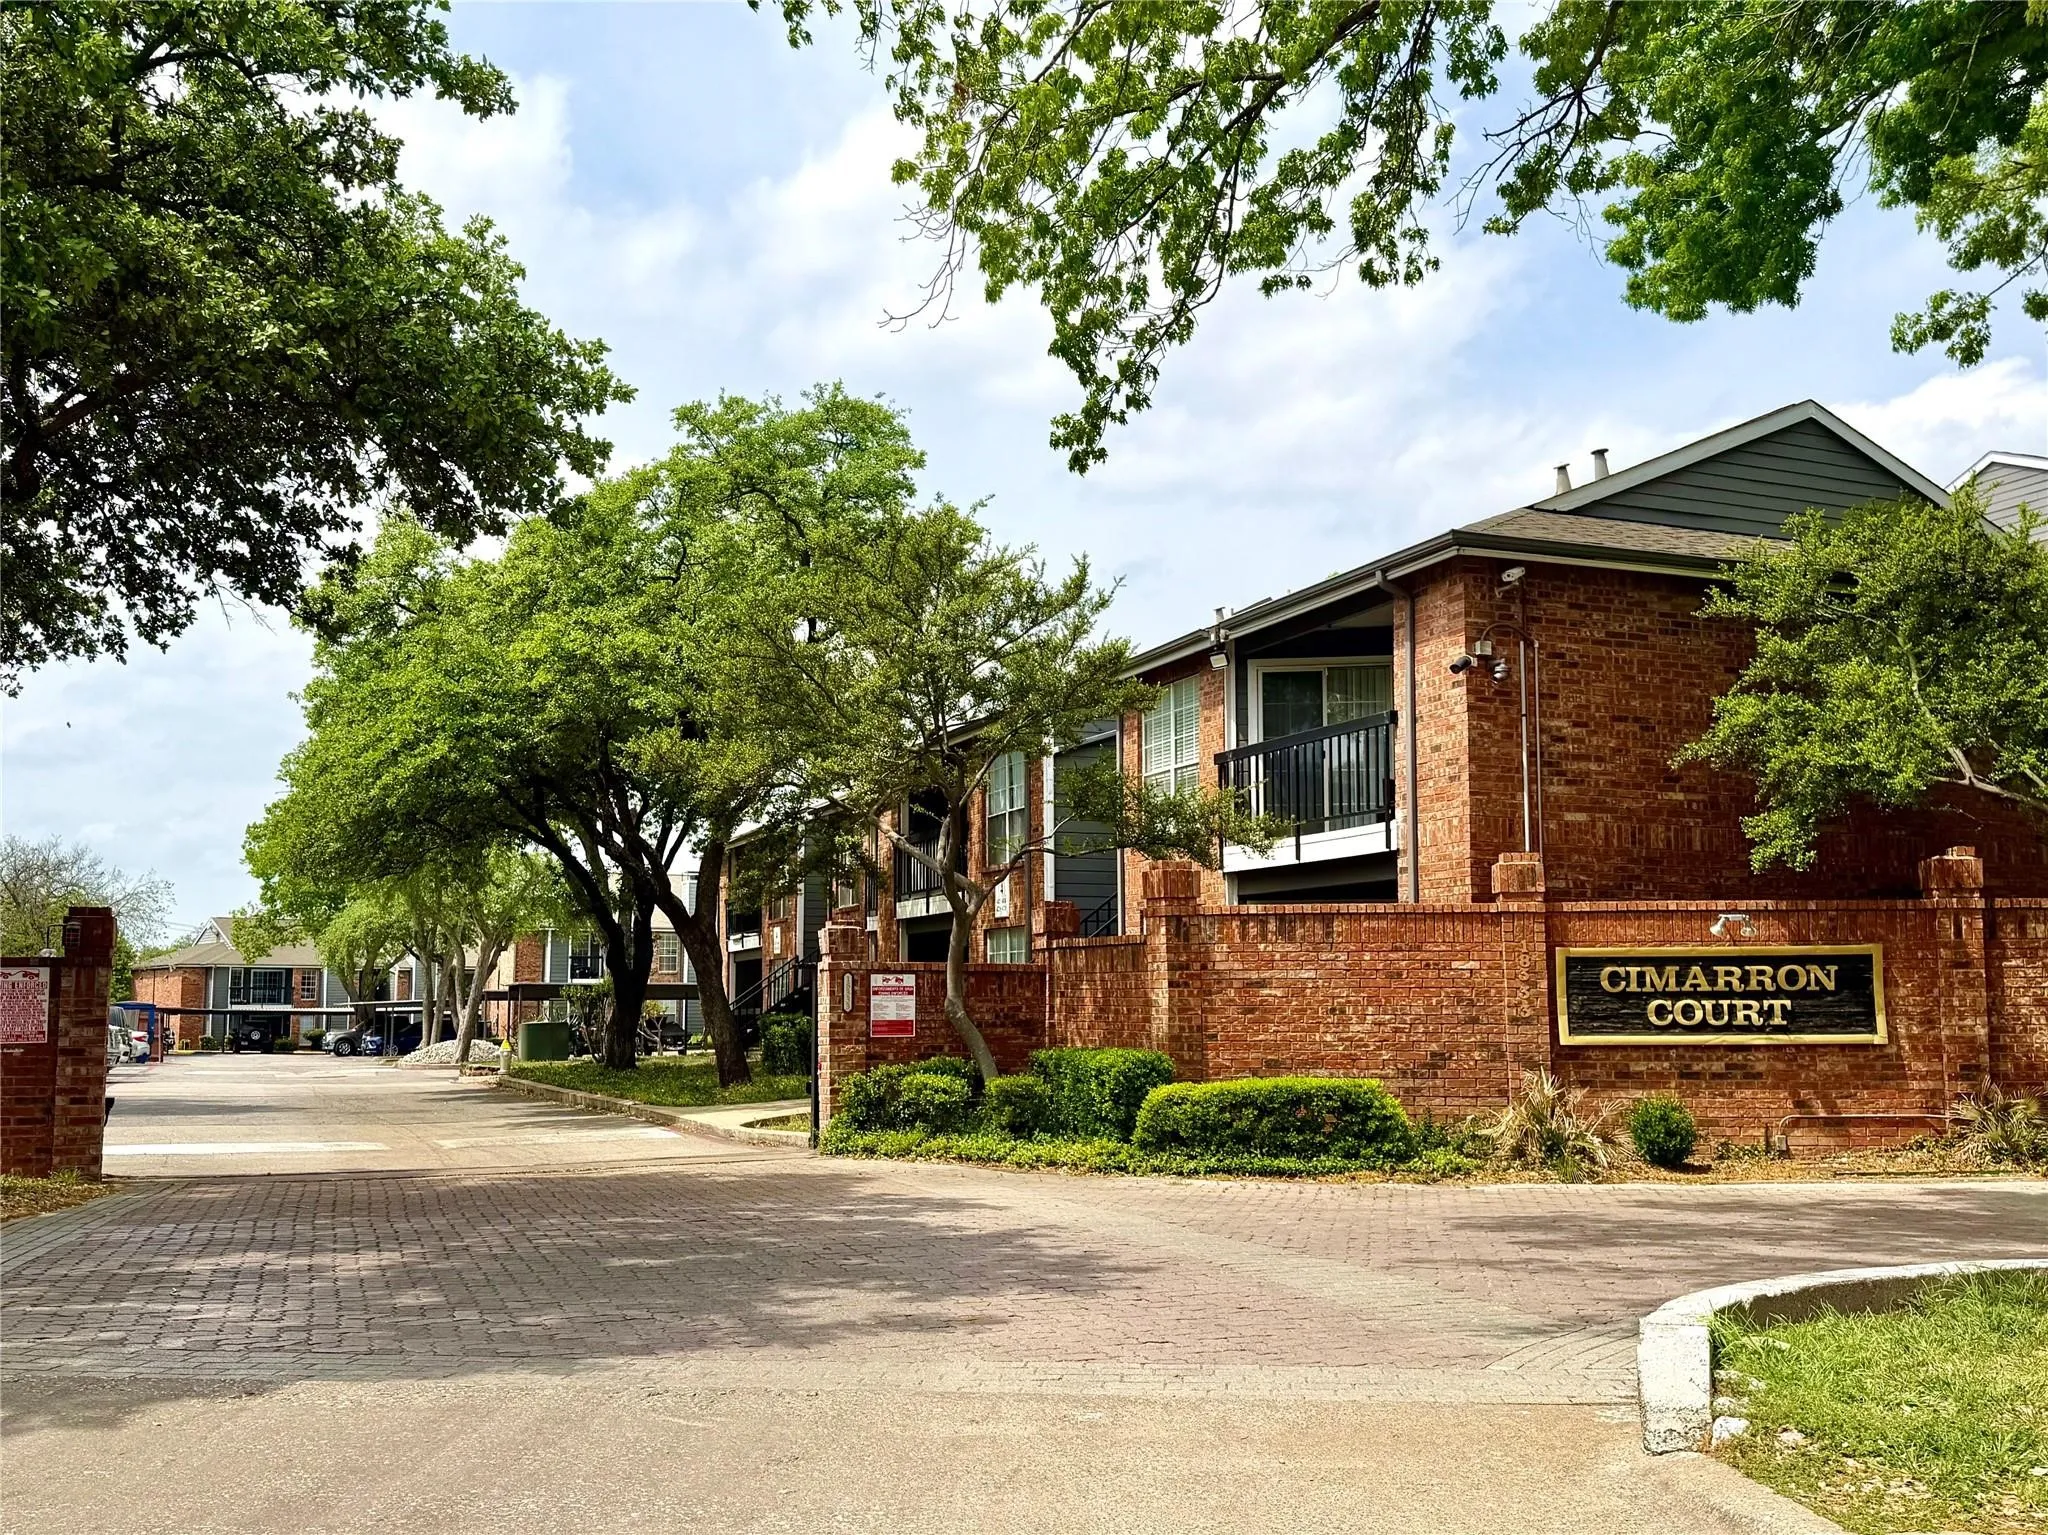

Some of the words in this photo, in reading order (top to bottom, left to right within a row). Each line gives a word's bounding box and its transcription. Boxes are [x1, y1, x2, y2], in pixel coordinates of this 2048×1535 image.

[14, 981, 47, 989] ENFORCED
[1599, 965, 1839, 993] CIMARRON
[1647, 998, 1793, 1027] COURT
